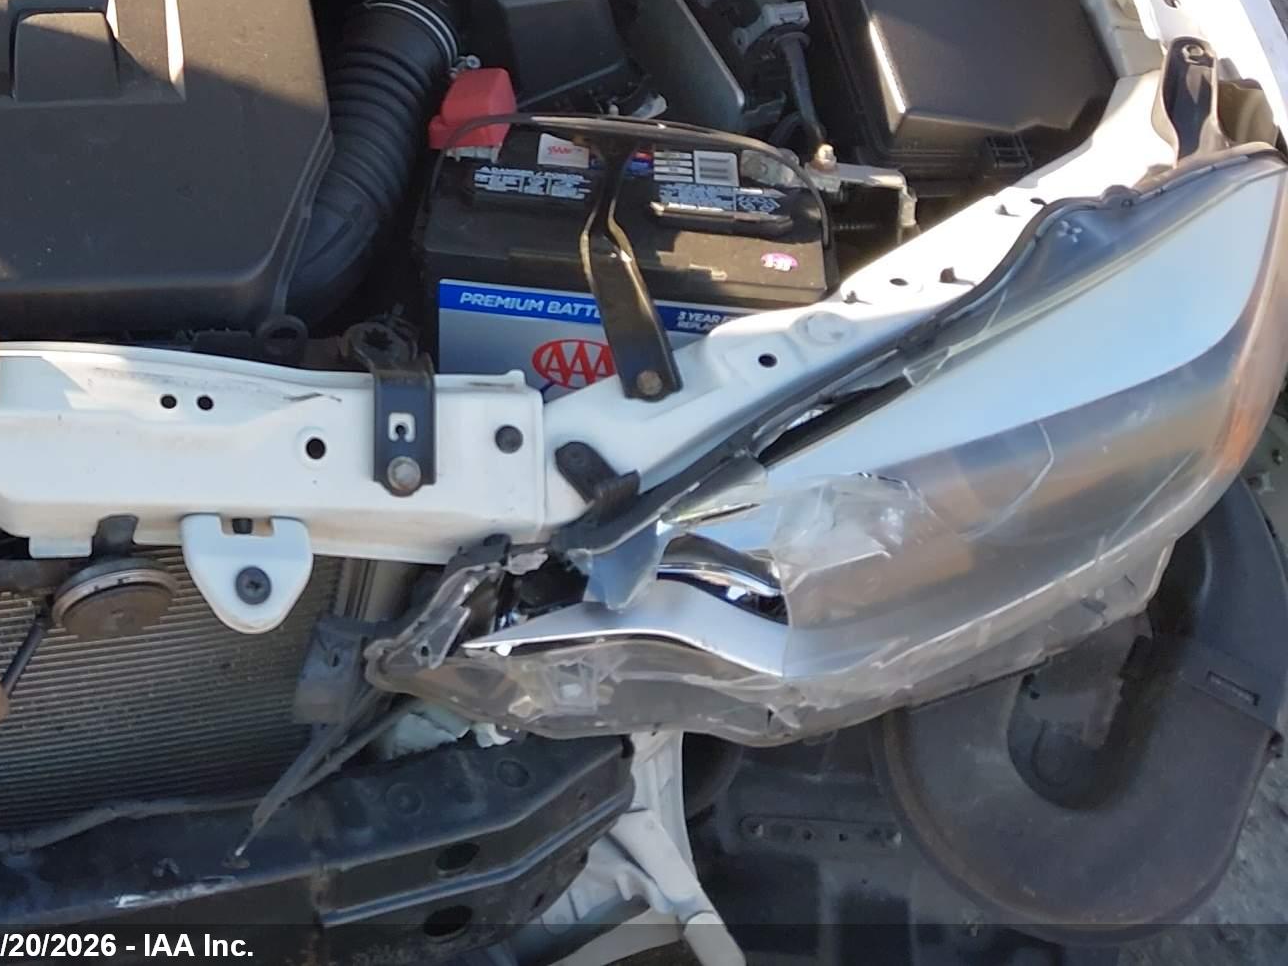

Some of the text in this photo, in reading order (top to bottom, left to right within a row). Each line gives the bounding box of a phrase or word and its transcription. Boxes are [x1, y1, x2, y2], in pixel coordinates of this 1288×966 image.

[459, 291, 545, 312] PREMIUM
[688, 312, 721, 324] YEAR
[542, 341, 616, 387] AAA
